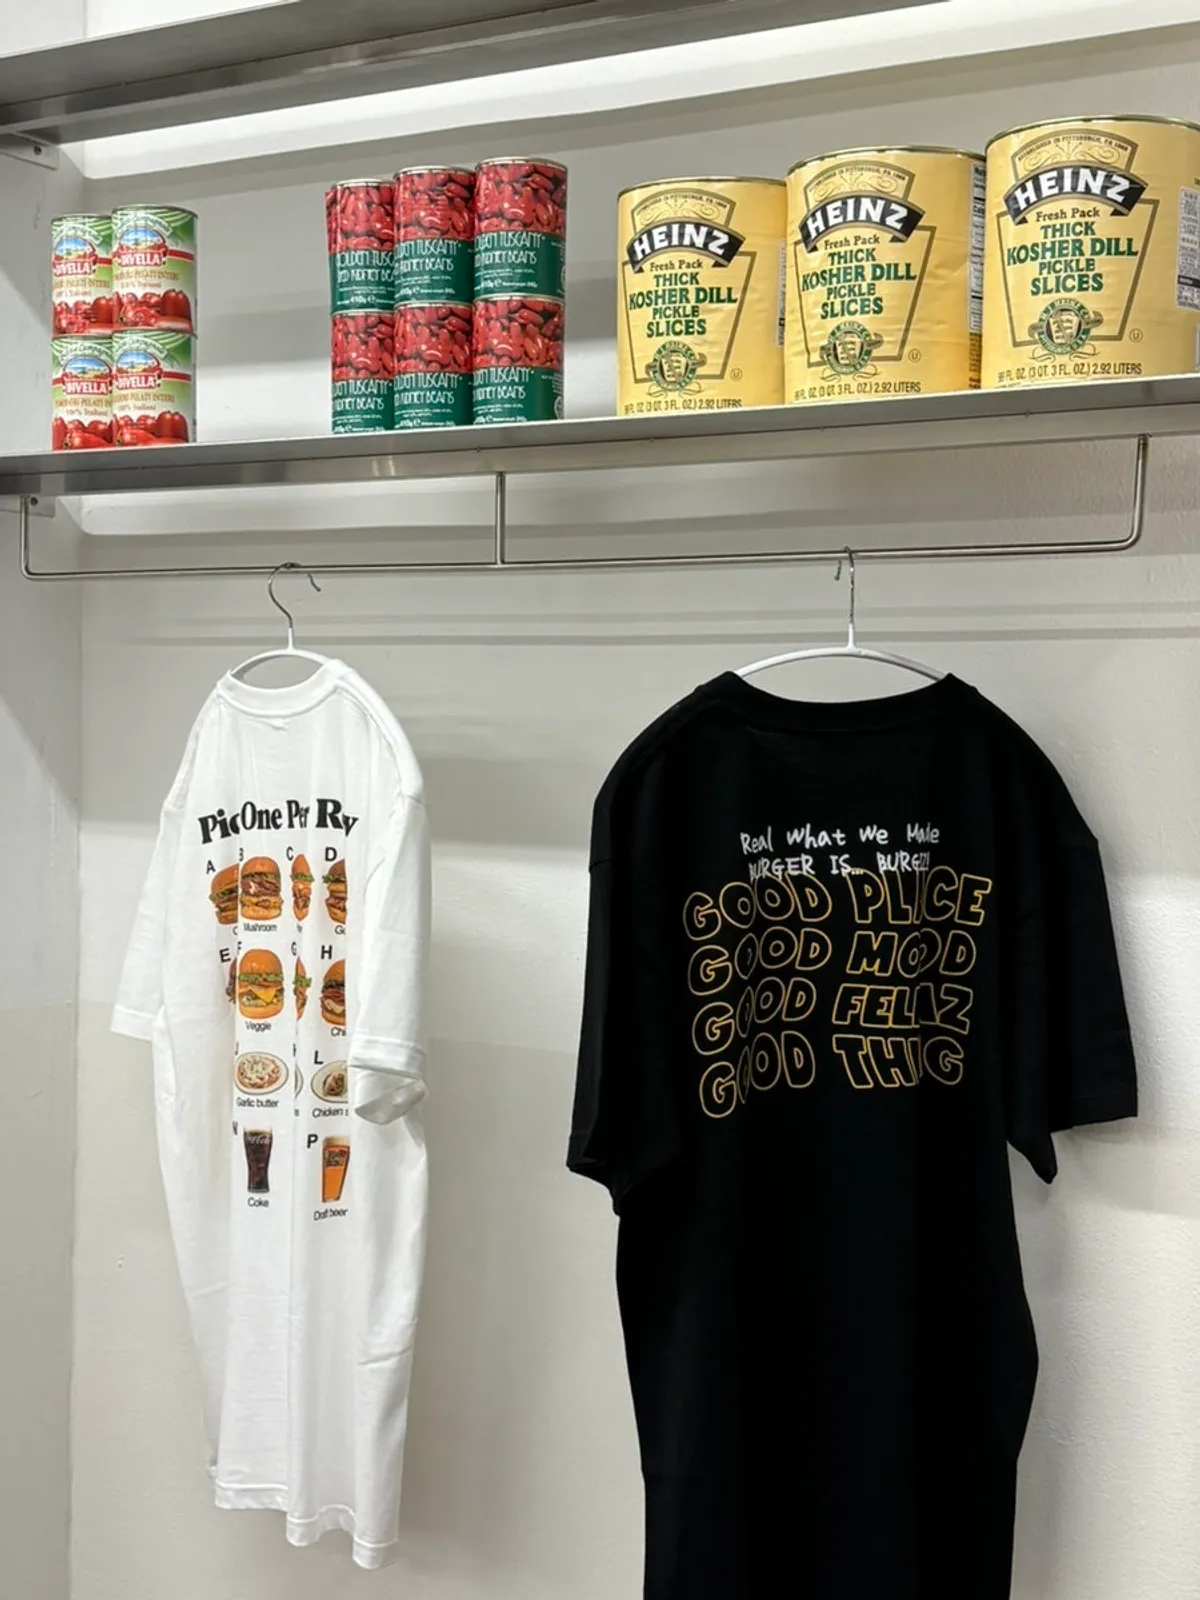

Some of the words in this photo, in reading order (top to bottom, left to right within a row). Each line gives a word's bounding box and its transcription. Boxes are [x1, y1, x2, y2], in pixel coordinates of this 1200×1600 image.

[1014, 167, 1130, 210] HEINZ
[806, 197, 908, 238] HEINZ
[1036, 210, 1066, 222] Fresh
[1071, 207, 1100, 218] Pack
[1040, 222, 1096, 240] THICK
[417, 239, 458, 255] TUSCANY
[500, 231, 542, 248] TUSCANY
[633, 223, 730, 261] HEINZ
[824, 236, 851, 250] Fresh
[854, 234, 880, 247] Pack
[372, 249, 394, 266] TUSC
[508, 250, 538, 264] BEANS
[828, 248, 876, 266] THICK
[1007, 238, 1085, 267] KOSHER
[1090, 237, 1139, 258] DILL
[425, 258, 454, 271] BEANS
[649, 259, 675, 272] Fresh
[678, 258, 704, 270] Pack
[1038, 258, 1095, 276] PICKLE
[653, 272, 700, 288] THICK
[801, 264, 866, 292] KOSHER
[870, 262, 917, 282] DILL
[1031, 273, 1104, 297] SLICES
[629, 288, 690, 311] KOSHER
[694, 286, 738, 304] DILL
[826, 282, 876, 301] PICKLE
[652, 306, 700, 320] PICKLE
[820, 297, 884, 320] SLICES
[646, 318, 707, 338] SLICES
[490, 366, 531, 383] TUSCANY
[1051, 364, 1057, 376] 3
[1092, 362, 1112, 374] 2.92
[1113, 362, 1142, 375] LITERS
[349, 379, 389, 395] TUSCANY
[418, 372, 459, 389] TUSCANY
[874, 382, 892, 393] 2.92
[894, 381, 921, 393] LITERS
[426, 390, 455, 404] BEANS
[498, 386, 526, 399] BEANS
[357, 396, 384, 410] BEANS
[716, 398, 742, 409] LITERS
[198, 808, 240, 844] Pic
[241, 801, 283, 830] One
[740, 826, 774, 855] Real
[324, 846, 338, 862] D
[206, 860, 216, 875] A
[682, 871, 833, 941] GOOD
[219, 948, 231, 963] E
[320, 944, 333, 960] H
[687, 926, 833, 996] GOOD
[692, 976, 818, 1056] GOOD
[245, 1021, 272, 1033] Veggie
[314, 1050, 324, 1065] L
[306, 1133, 319, 1149] P
[247, 1196, 270, 1208] Coke
